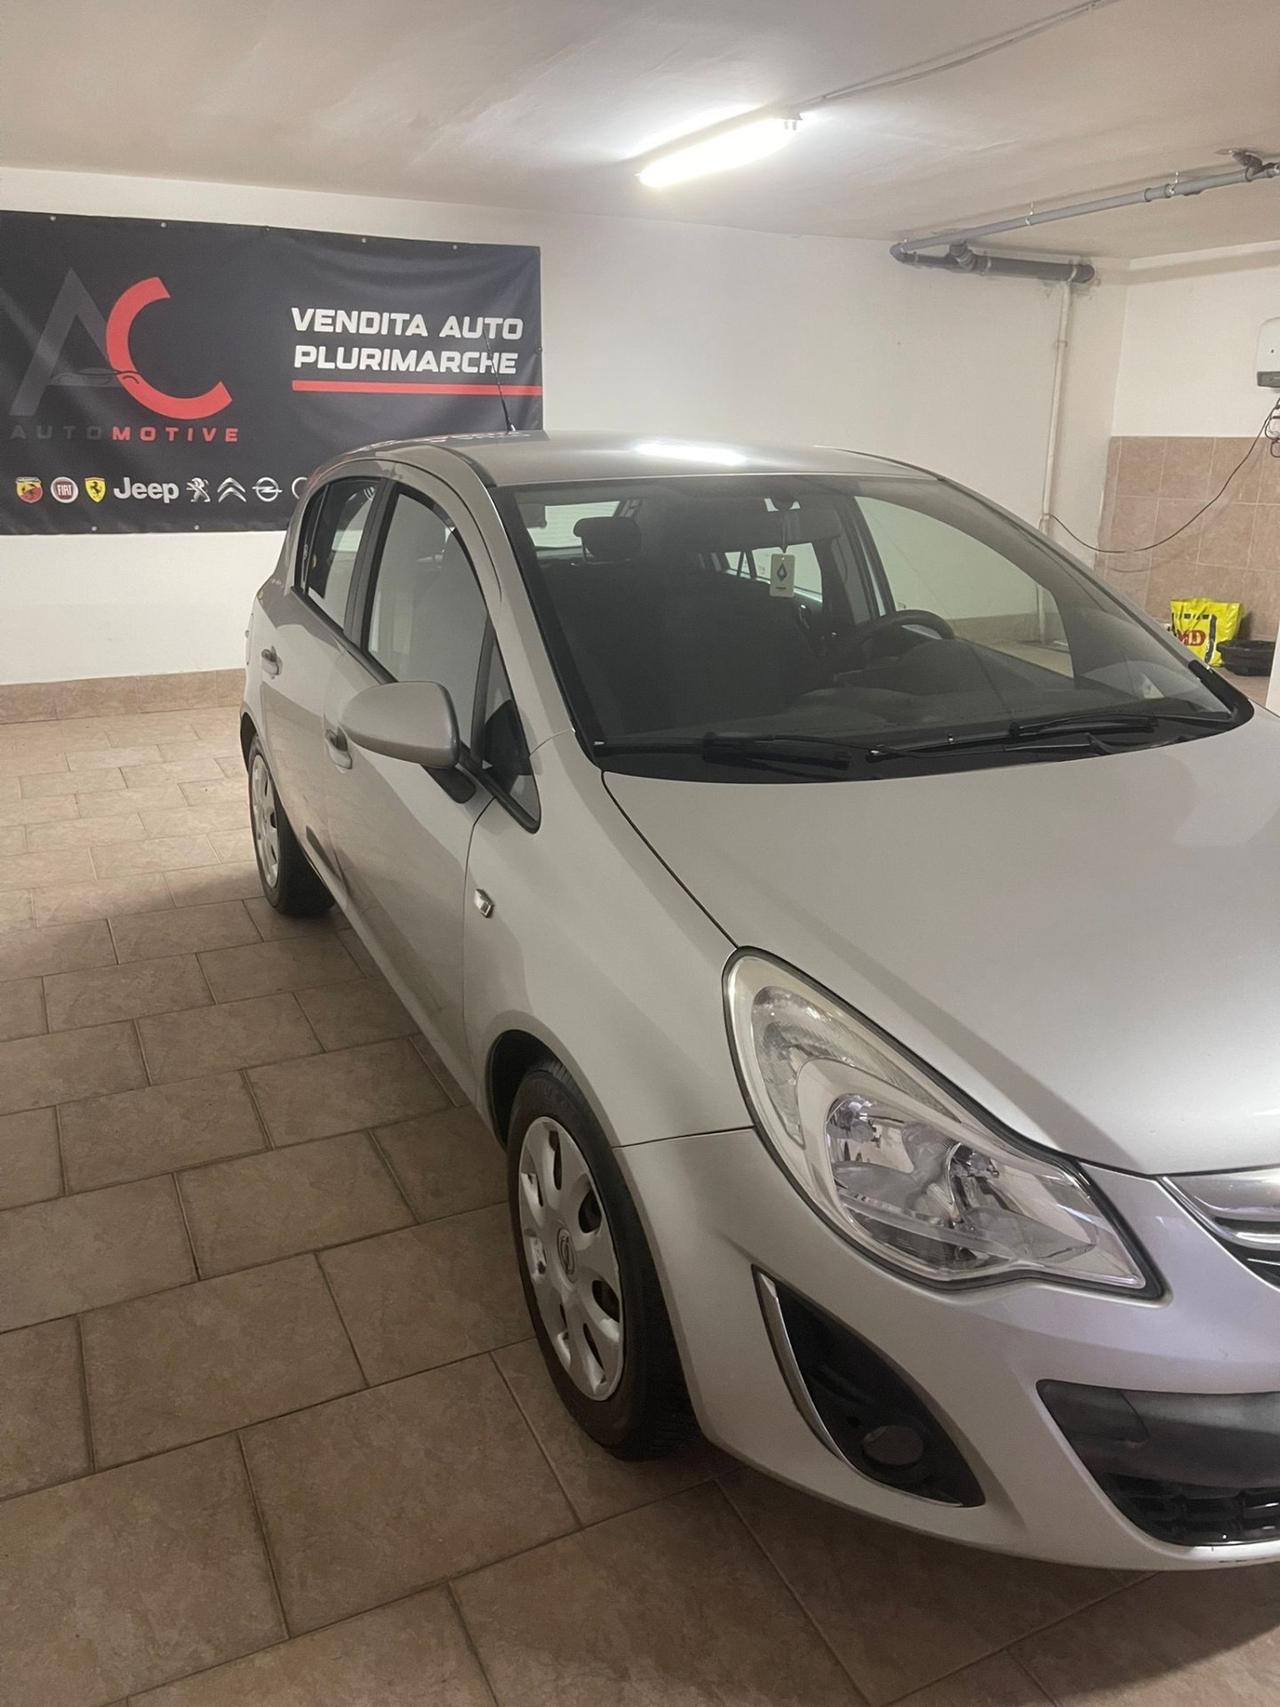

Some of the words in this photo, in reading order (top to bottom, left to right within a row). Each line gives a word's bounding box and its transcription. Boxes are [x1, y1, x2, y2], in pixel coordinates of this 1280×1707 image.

[291, 307, 428, 337] VENDITA
[439, 315, 524, 341] AUTO
[294, 345, 519, 375] PLURIMARCHE
[9, 425, 239, 443] AUTOMOTIVE
[113, 477, 180, 503] Jeep
